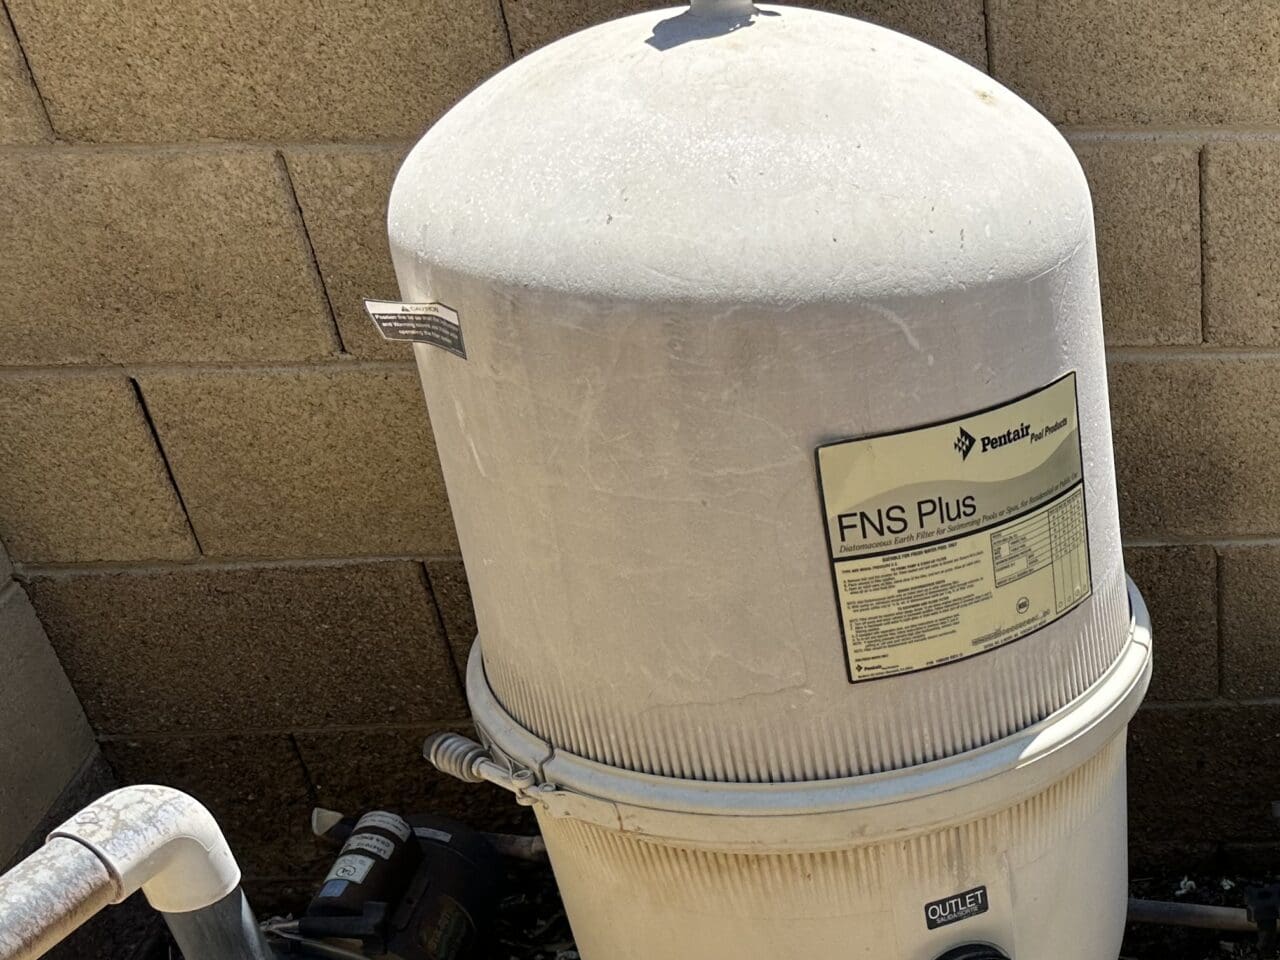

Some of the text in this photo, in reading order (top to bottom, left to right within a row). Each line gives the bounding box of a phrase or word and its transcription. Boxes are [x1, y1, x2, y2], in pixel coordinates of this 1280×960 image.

[980, 422, 1031, 453] Pentair
[1030, 417, 1068, 444] Pool Products
[837, 495, 977, 542] FNS Plus
[839, 539, 893, 553] Diatomaceous
[894, 535, 915, 545] Earth
[916, 529, 935, 541] Filter
[935, 526, 946, 537] for
[982, 511, 998, 523] Pools
[928, 889, 984, 919] OUTLET
